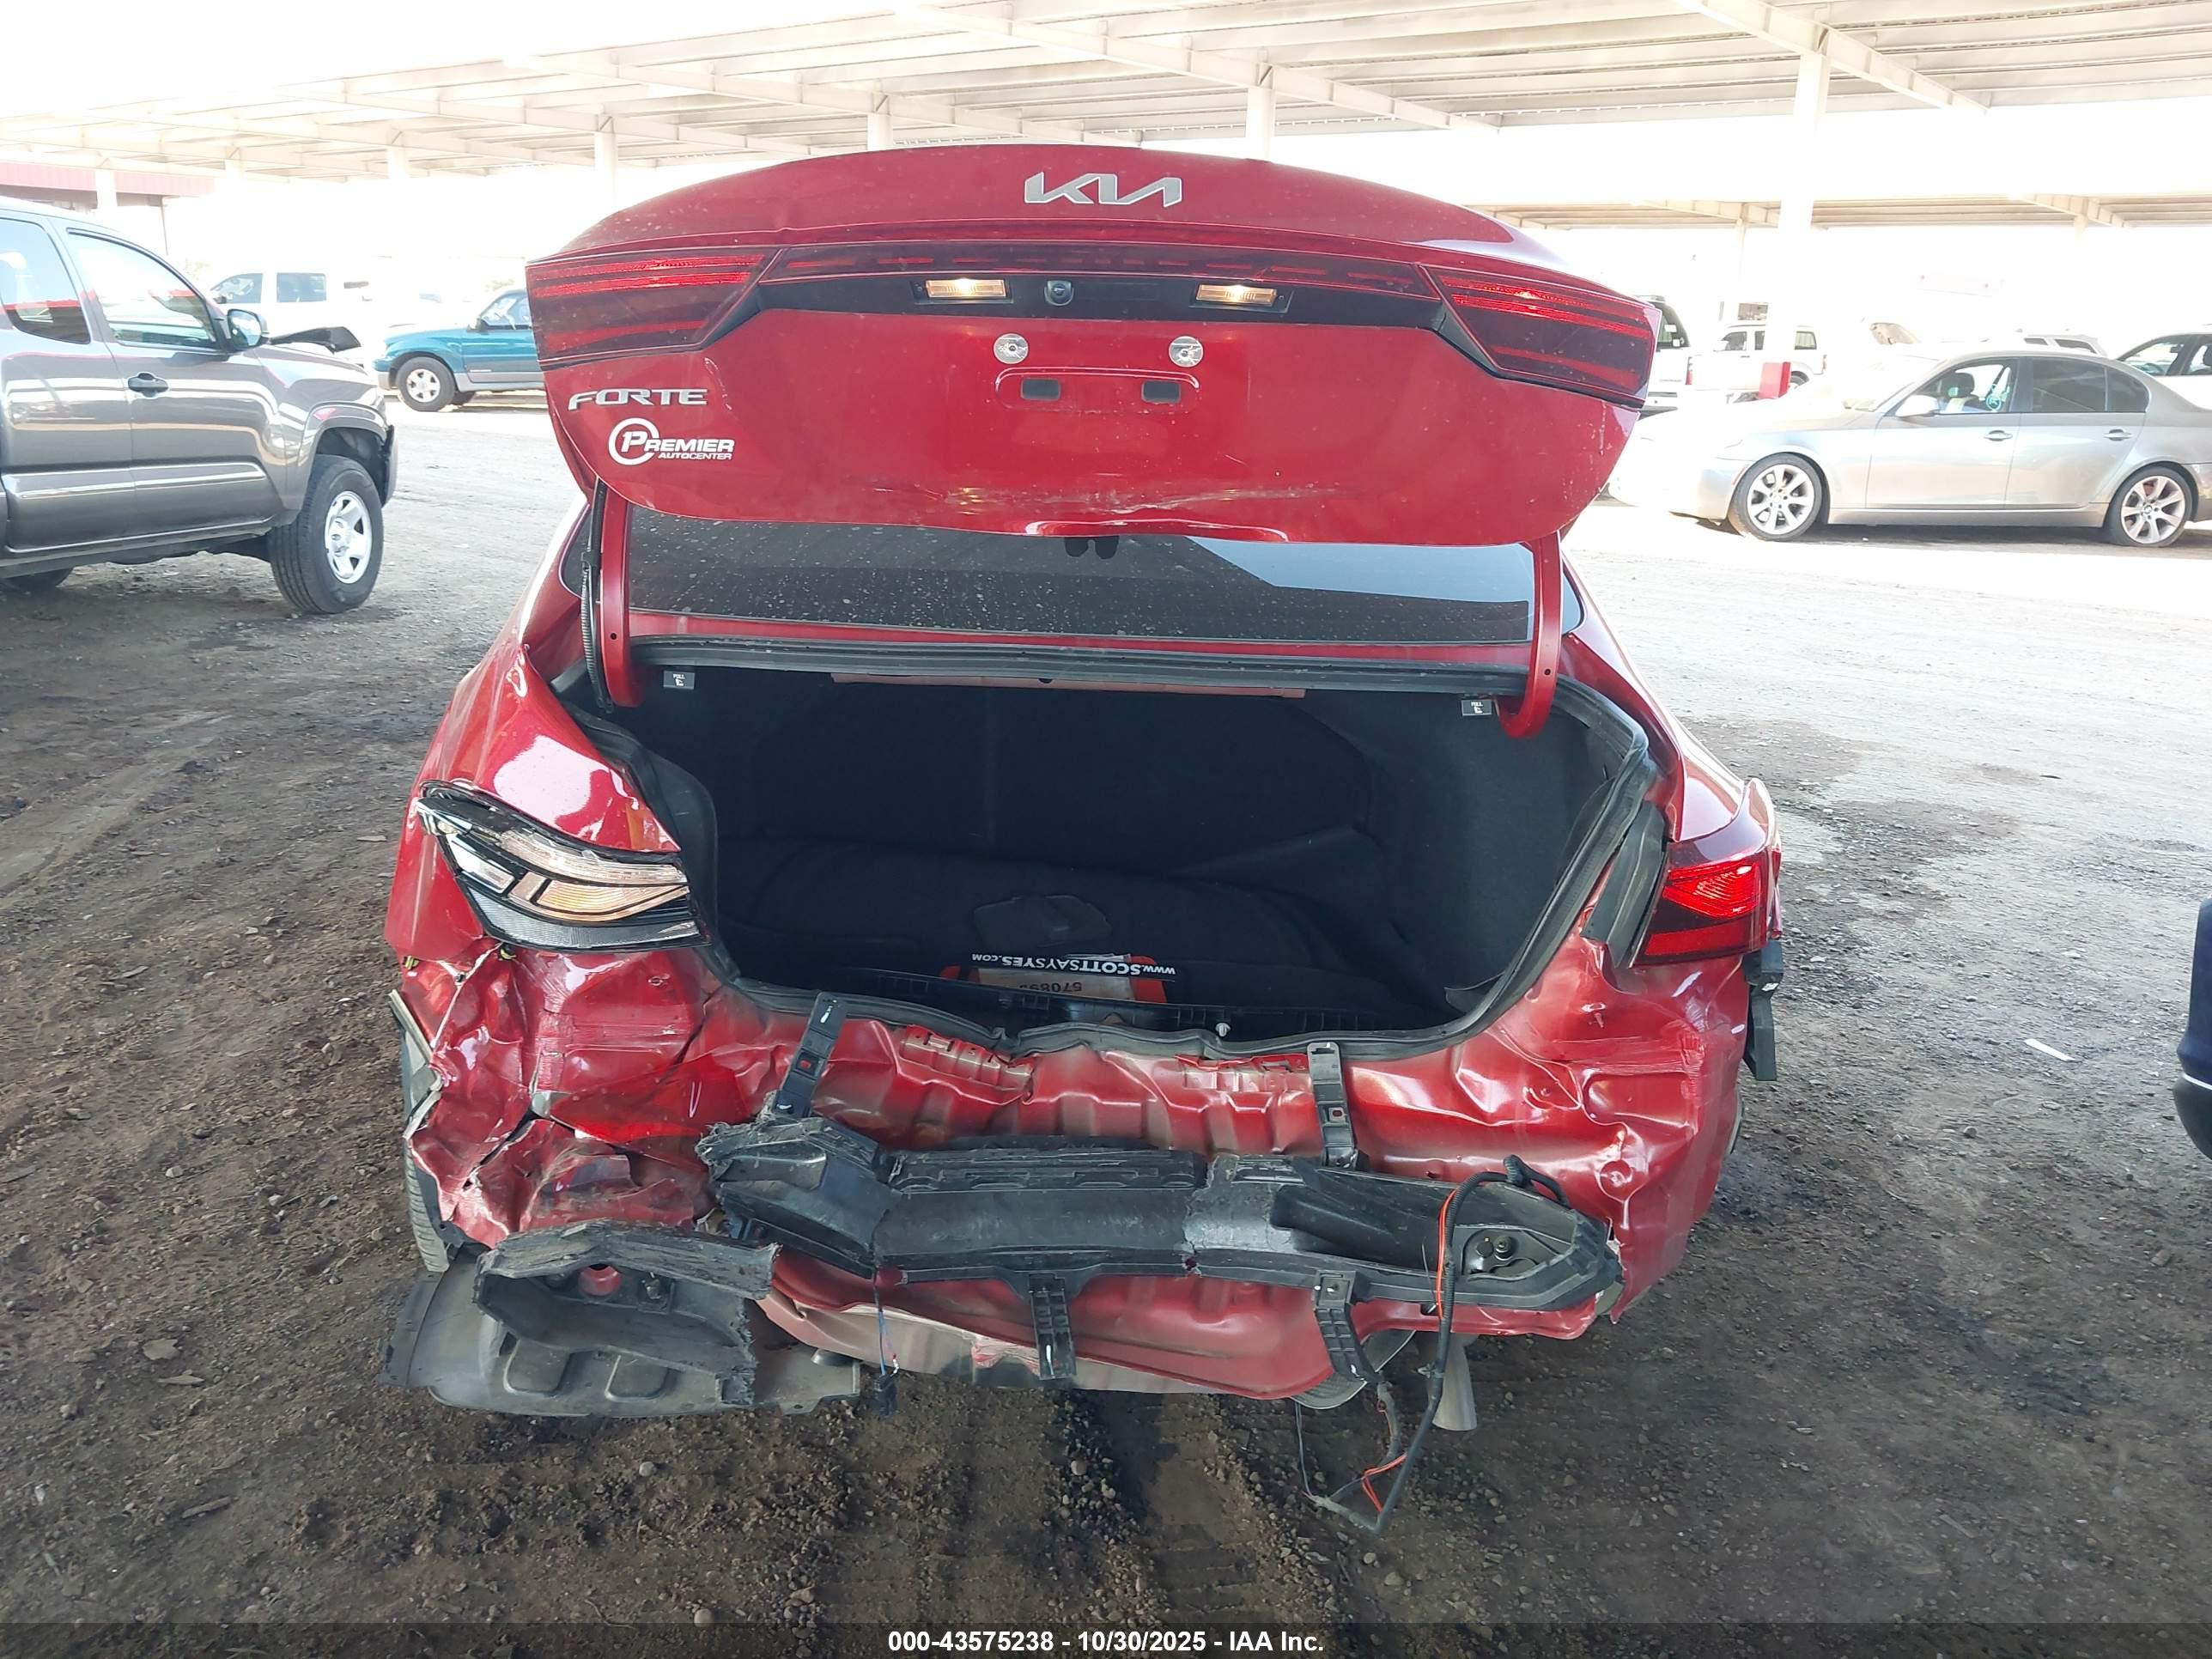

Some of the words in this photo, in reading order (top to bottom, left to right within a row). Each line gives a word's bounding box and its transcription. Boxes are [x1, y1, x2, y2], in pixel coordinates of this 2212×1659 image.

[1024, 171, 1182, 208] KIA
[568, 388, 708, 410] FORTE
[621, 431, 735, 453] PREMIER
[658, 452, 732, 460] AUTOCENTER
